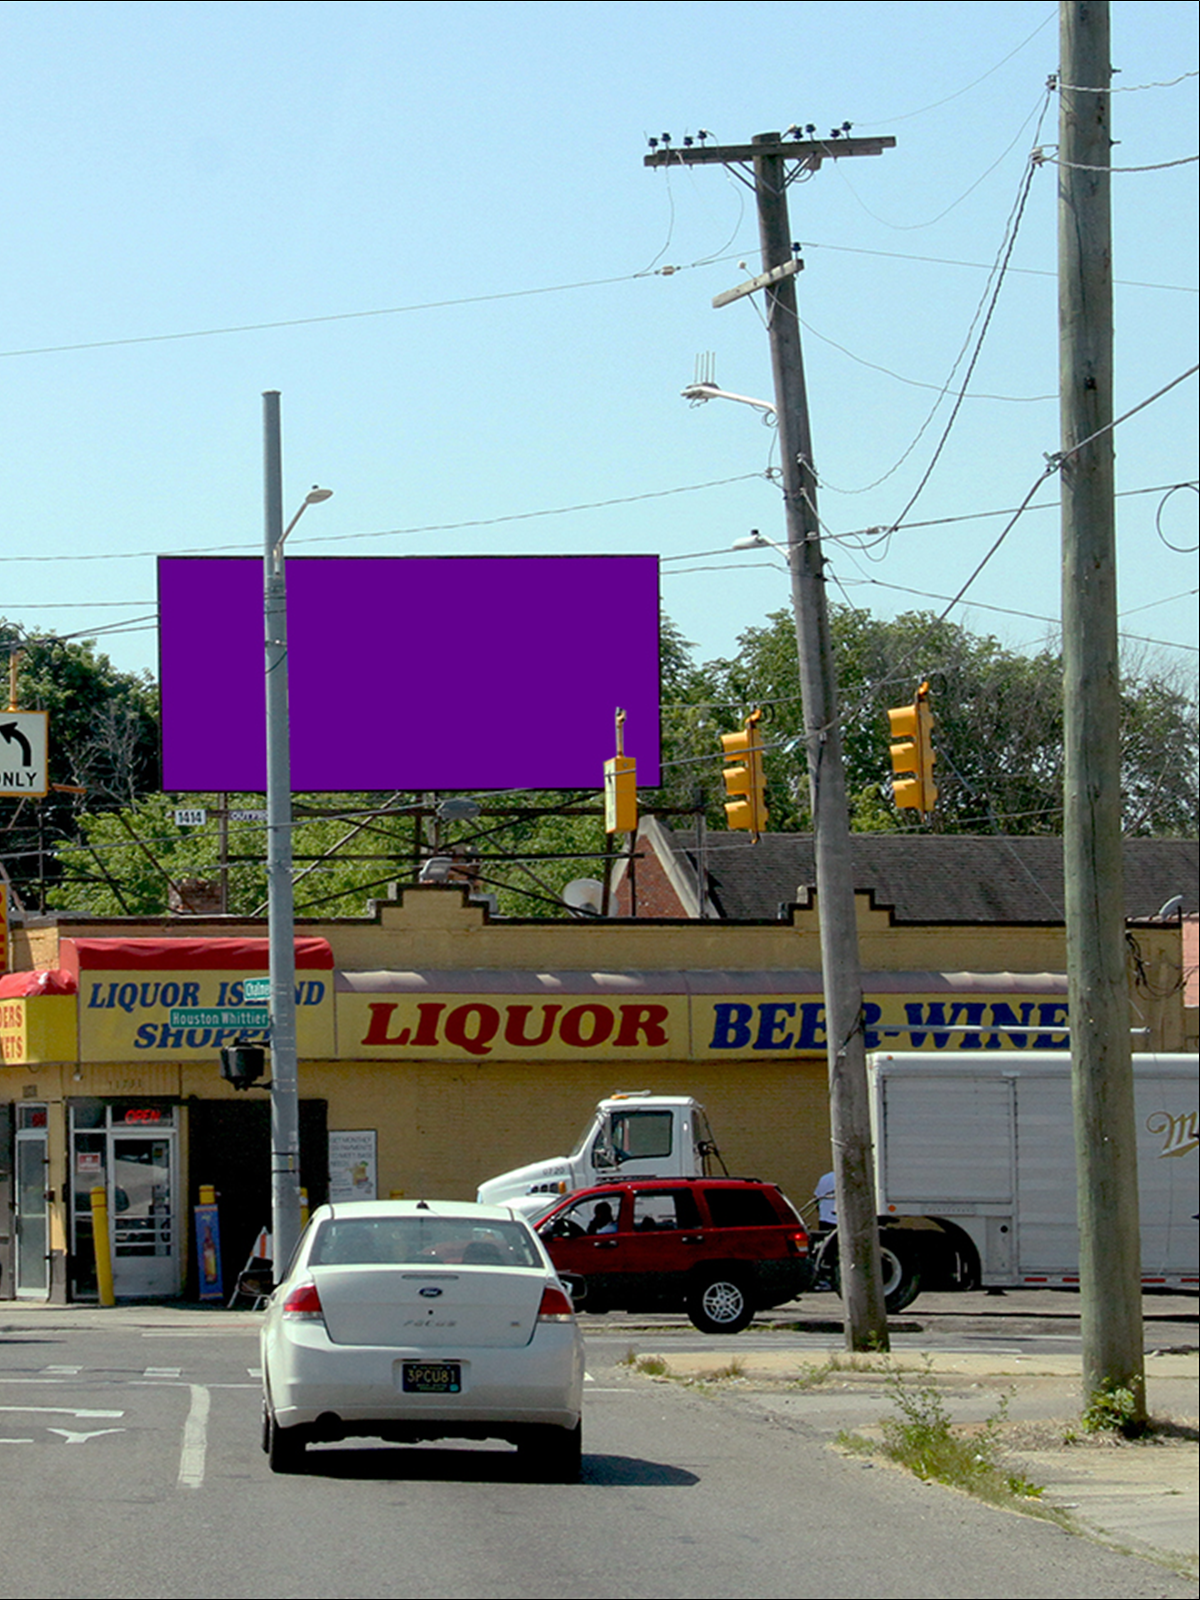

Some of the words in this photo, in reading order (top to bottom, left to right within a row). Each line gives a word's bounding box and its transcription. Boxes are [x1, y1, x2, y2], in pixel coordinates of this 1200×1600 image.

[87, 982, 200, 1013] LIQUOR
[215, 981, 325, 1006] ISND
[172, 1013, 219, 1025] Houston
[221, 1012, 268, 1025] Whittier
[361, 1003, 669, 1055] LIQUOR
[133, 1023, 271, 1049] SHOPP
[124, 1109, 162, 1125] OPEN
